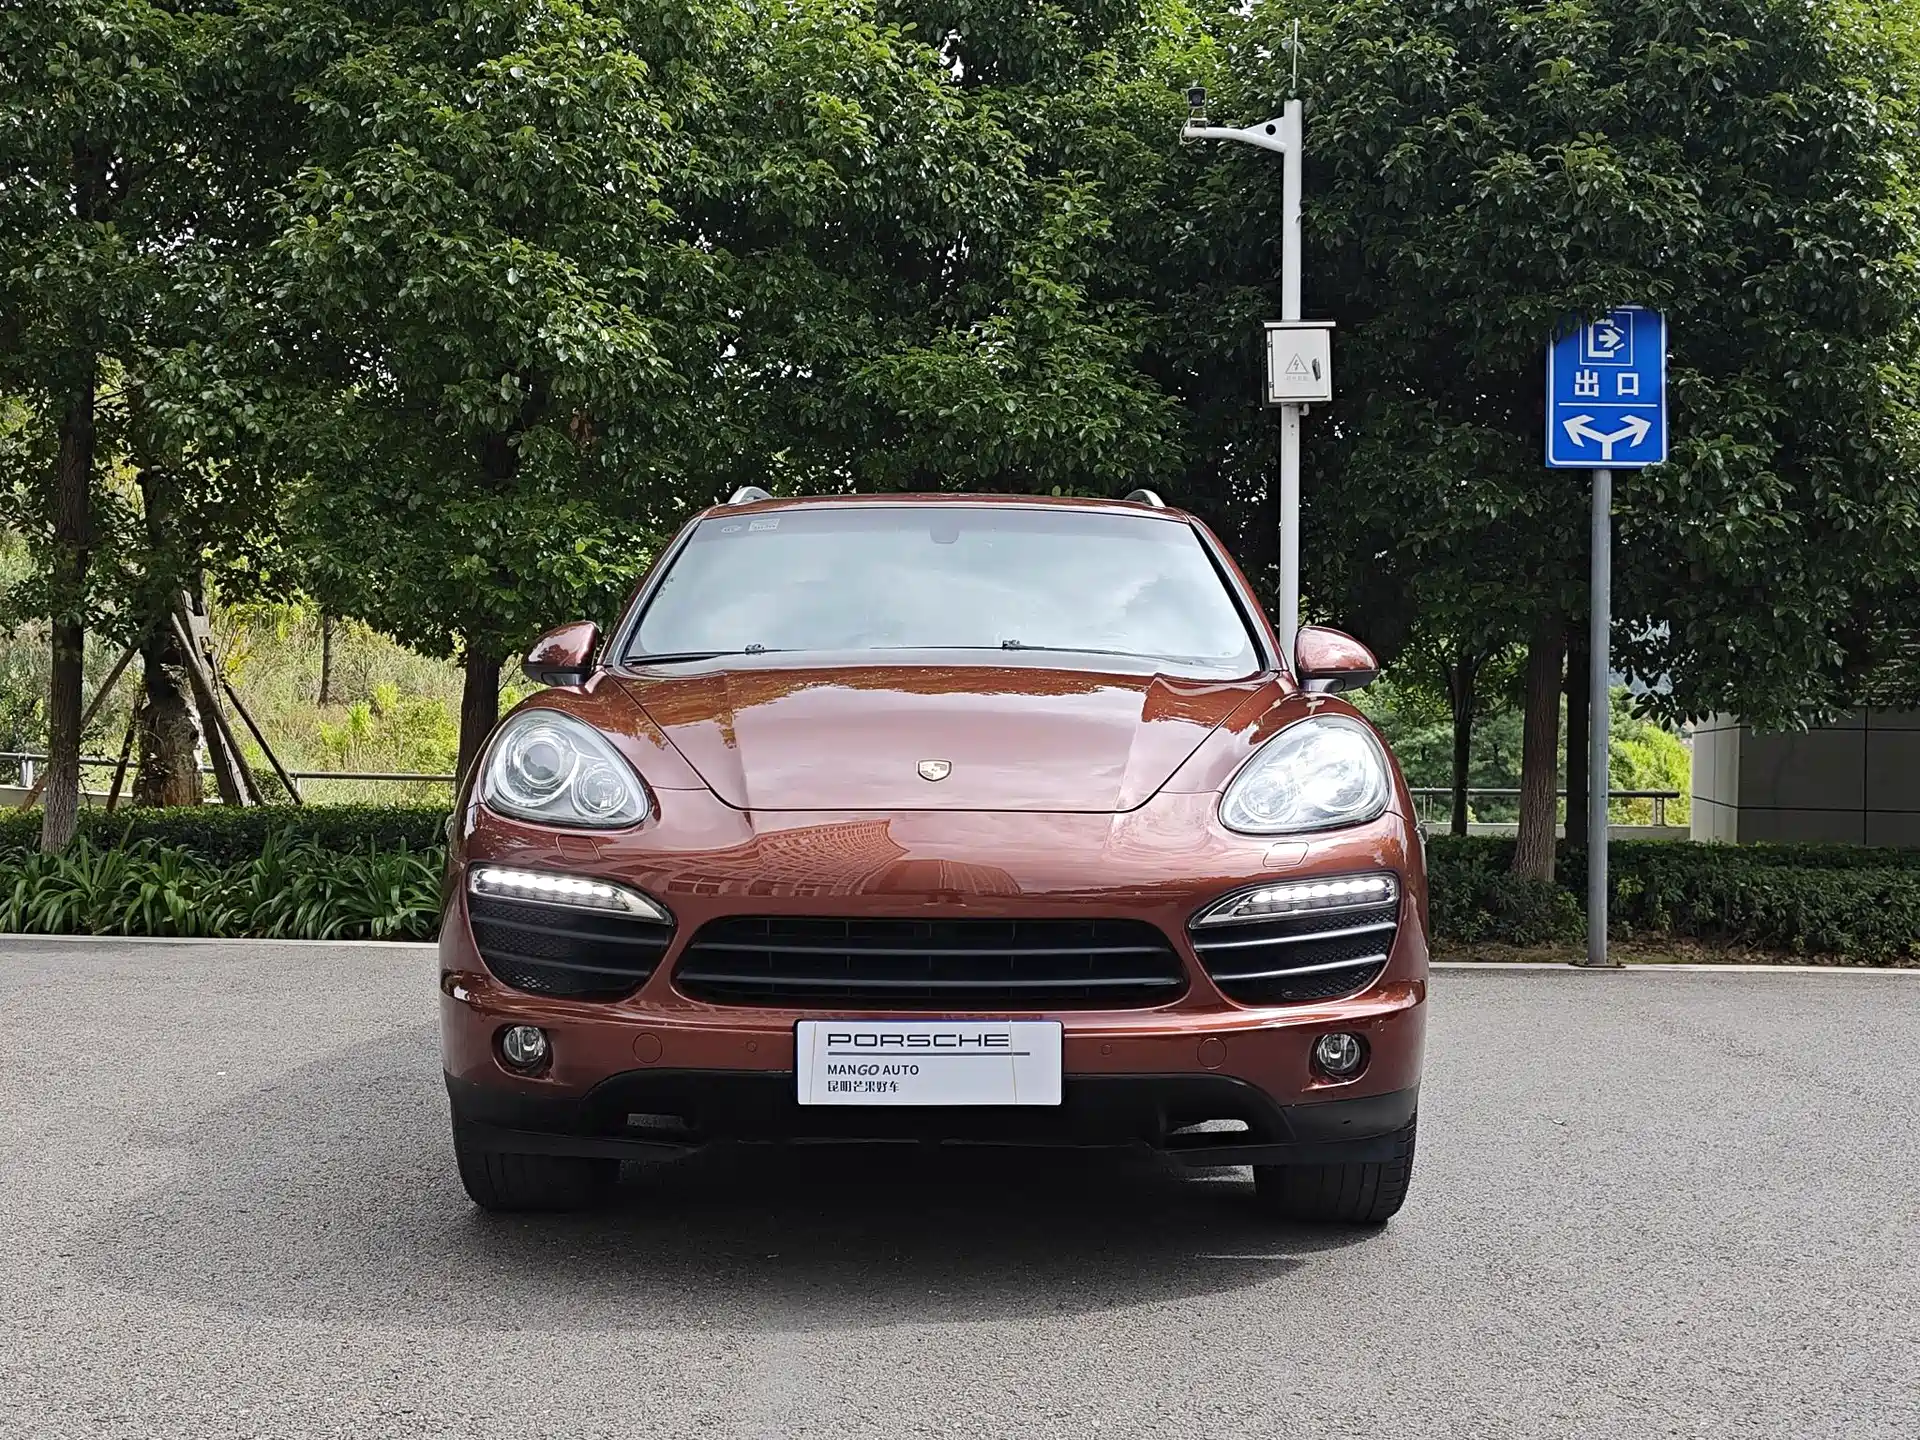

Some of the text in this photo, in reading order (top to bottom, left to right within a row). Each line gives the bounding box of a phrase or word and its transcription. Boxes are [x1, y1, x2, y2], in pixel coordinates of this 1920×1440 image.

[1574, 369, 1639, 397] 出口
[827, 1033, 1009, 1047] PORSCHE
[827, 1064, 920, 1076] MANGO AUTO
[827, 1080, 900, 1093] 昆明芒果好车
